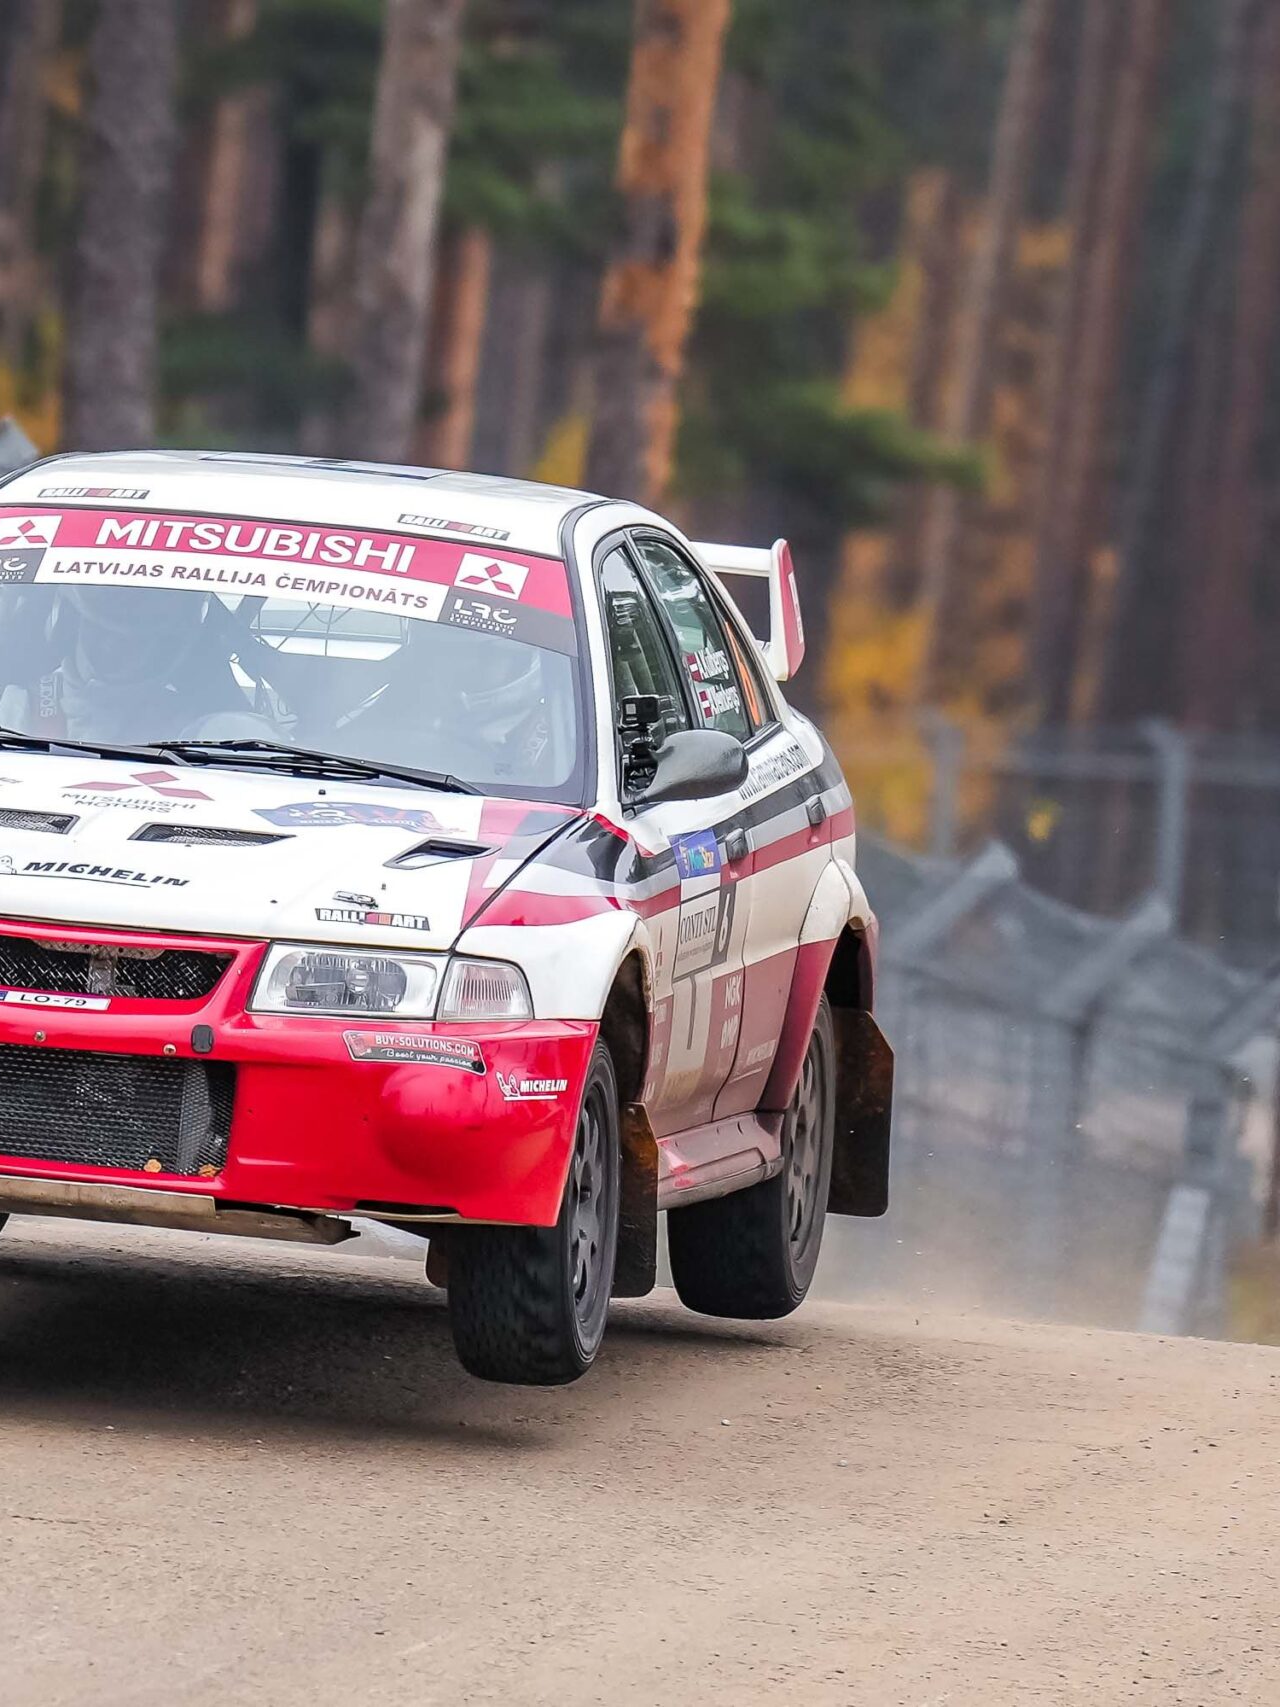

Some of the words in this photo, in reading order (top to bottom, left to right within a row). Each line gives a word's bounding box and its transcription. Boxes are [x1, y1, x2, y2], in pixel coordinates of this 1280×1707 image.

[94, 518, 417, 574] MITSUBISHI
[52, 561, 164, 578] LATVIJAS
[170, 566, 267, 587] RALLIJA
[274, 572, 429, 609] ČEMPIONĀTS
[61, 792, 197, 810] MITSUBISHI
[74, 799, 173, 814] MOTORS
[22, 861, 191, 887] MICHELIN
[19, 993, 88, 1007] LO-79
[375, 1034, 475, 1057] BUY-SOLUTIONS.COM
[416, 1053, 439, 1062] your
[519, 1078, 568, 1093] MICHELIN
